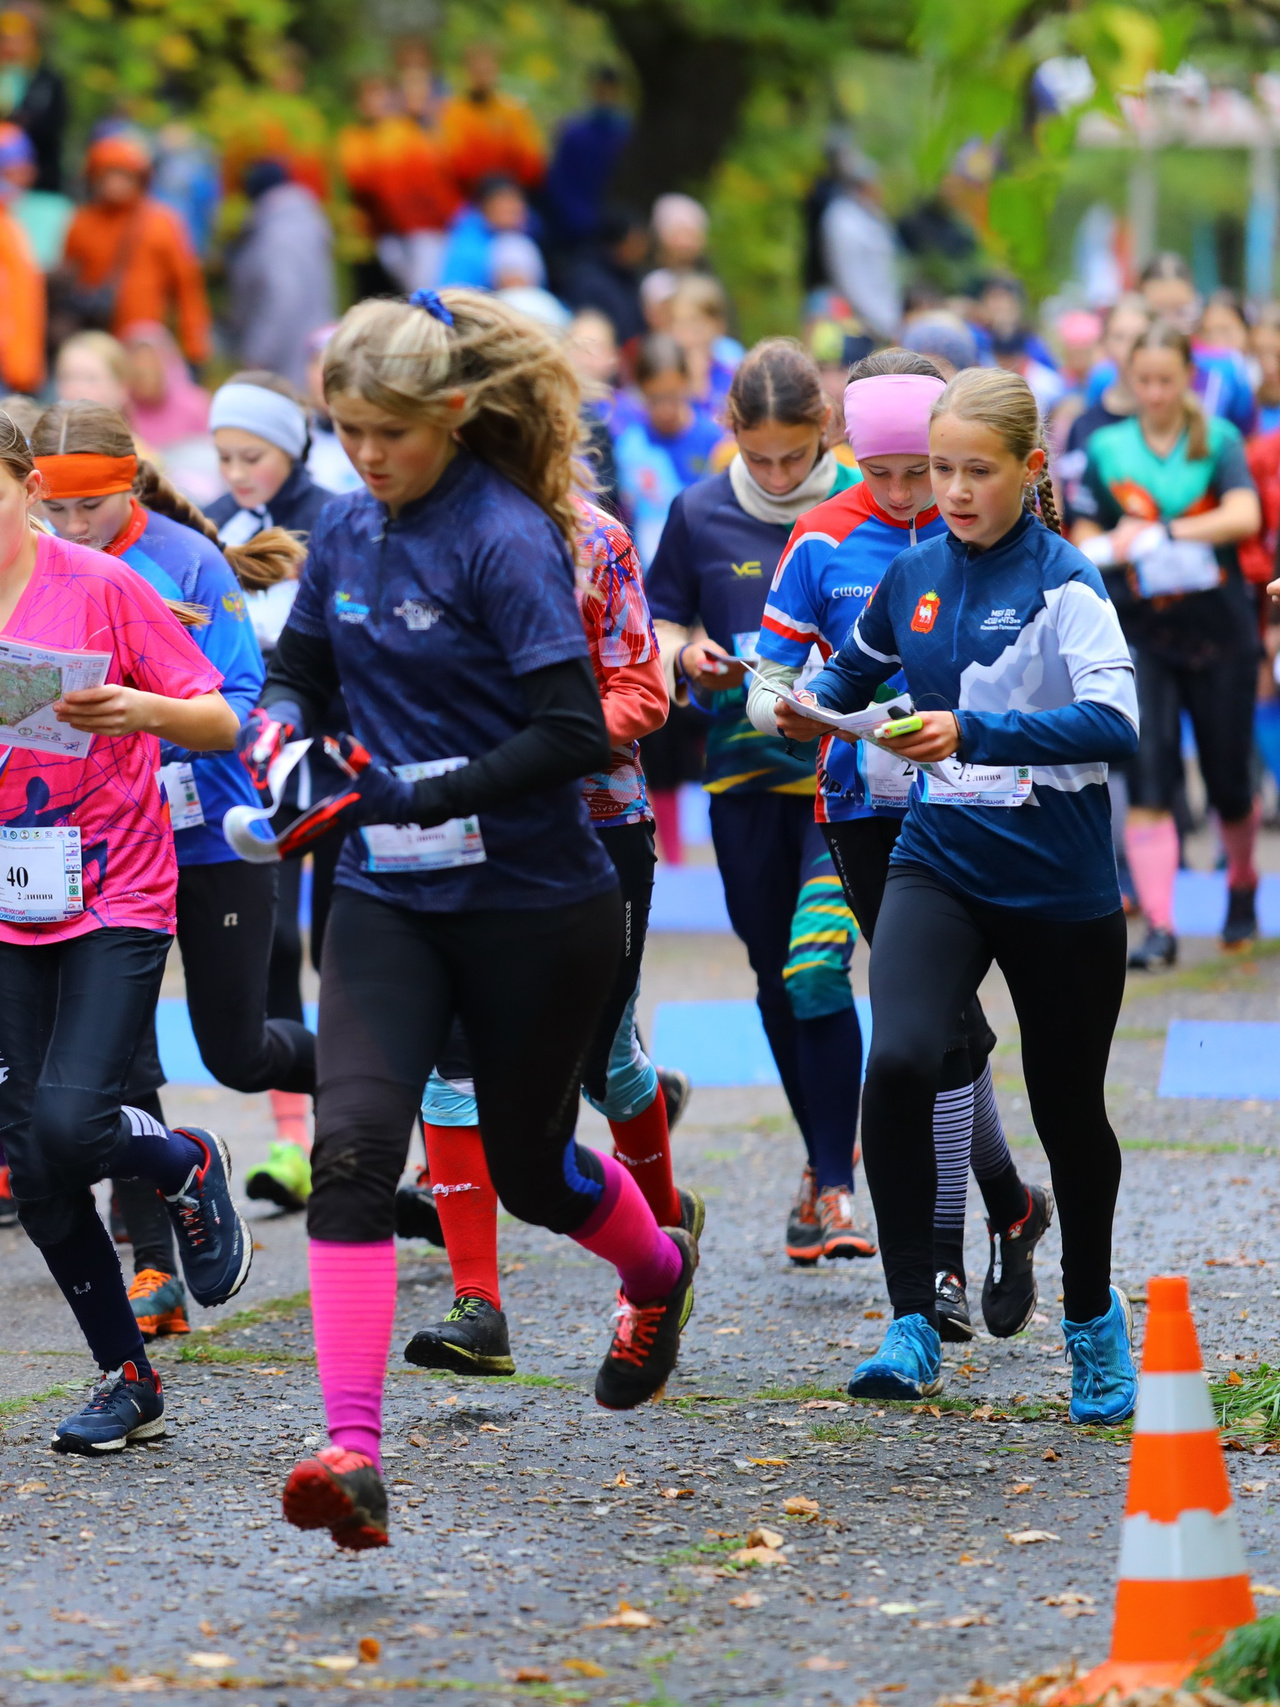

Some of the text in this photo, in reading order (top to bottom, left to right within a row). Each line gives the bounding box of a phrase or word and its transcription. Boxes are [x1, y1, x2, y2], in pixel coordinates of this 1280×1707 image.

[973, 774, 1001, 782] линия
[6, 866, 29, 888] 40
[17, 892, 22, 900] 2
